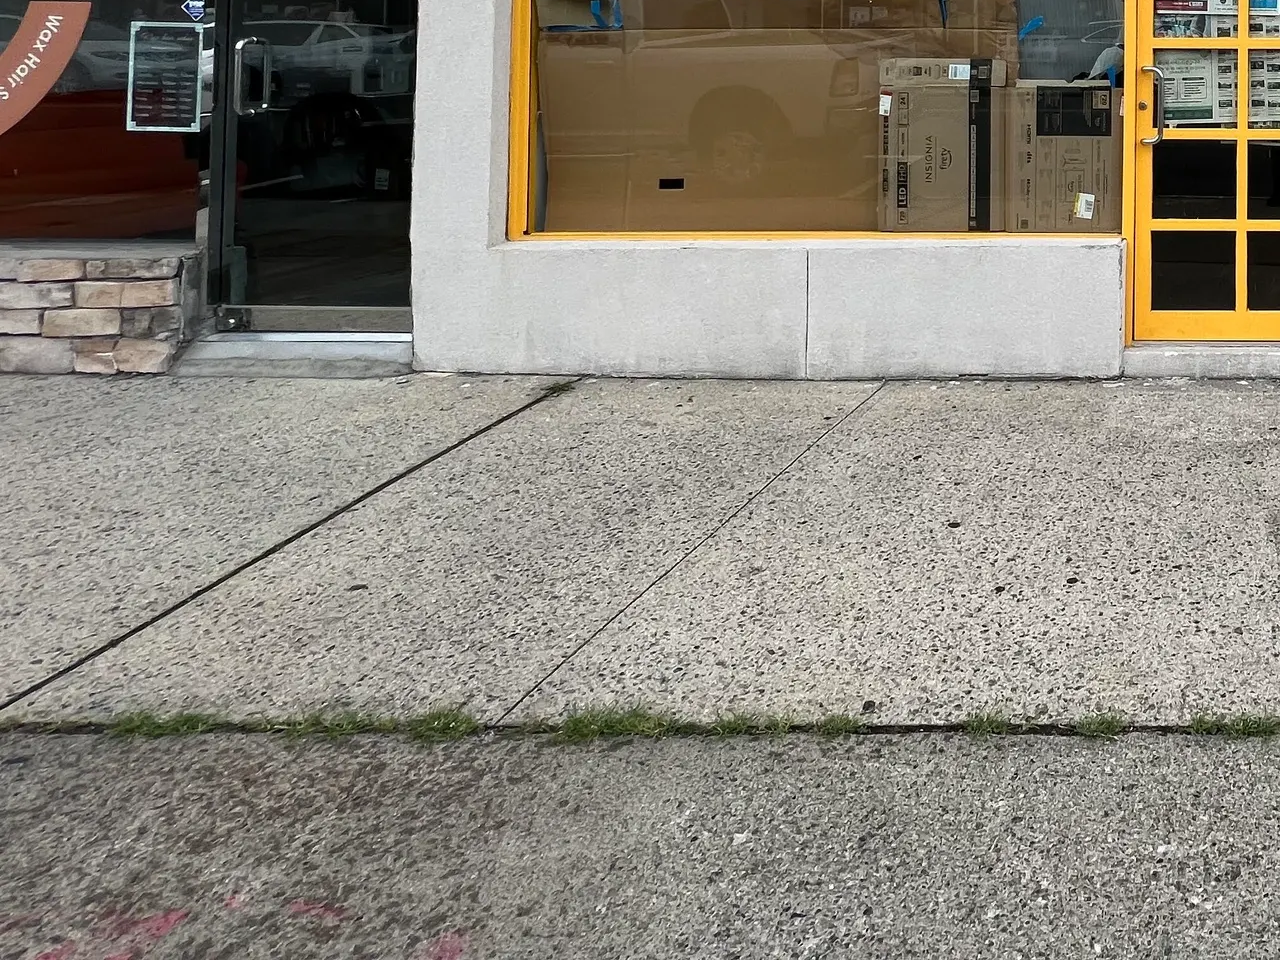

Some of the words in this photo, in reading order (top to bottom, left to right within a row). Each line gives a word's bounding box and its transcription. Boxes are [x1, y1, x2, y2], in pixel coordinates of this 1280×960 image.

[32, 15, 64, 53] Wax
[7, 53, 41, 88] Hair
[899, 187, 907, 205] LED
